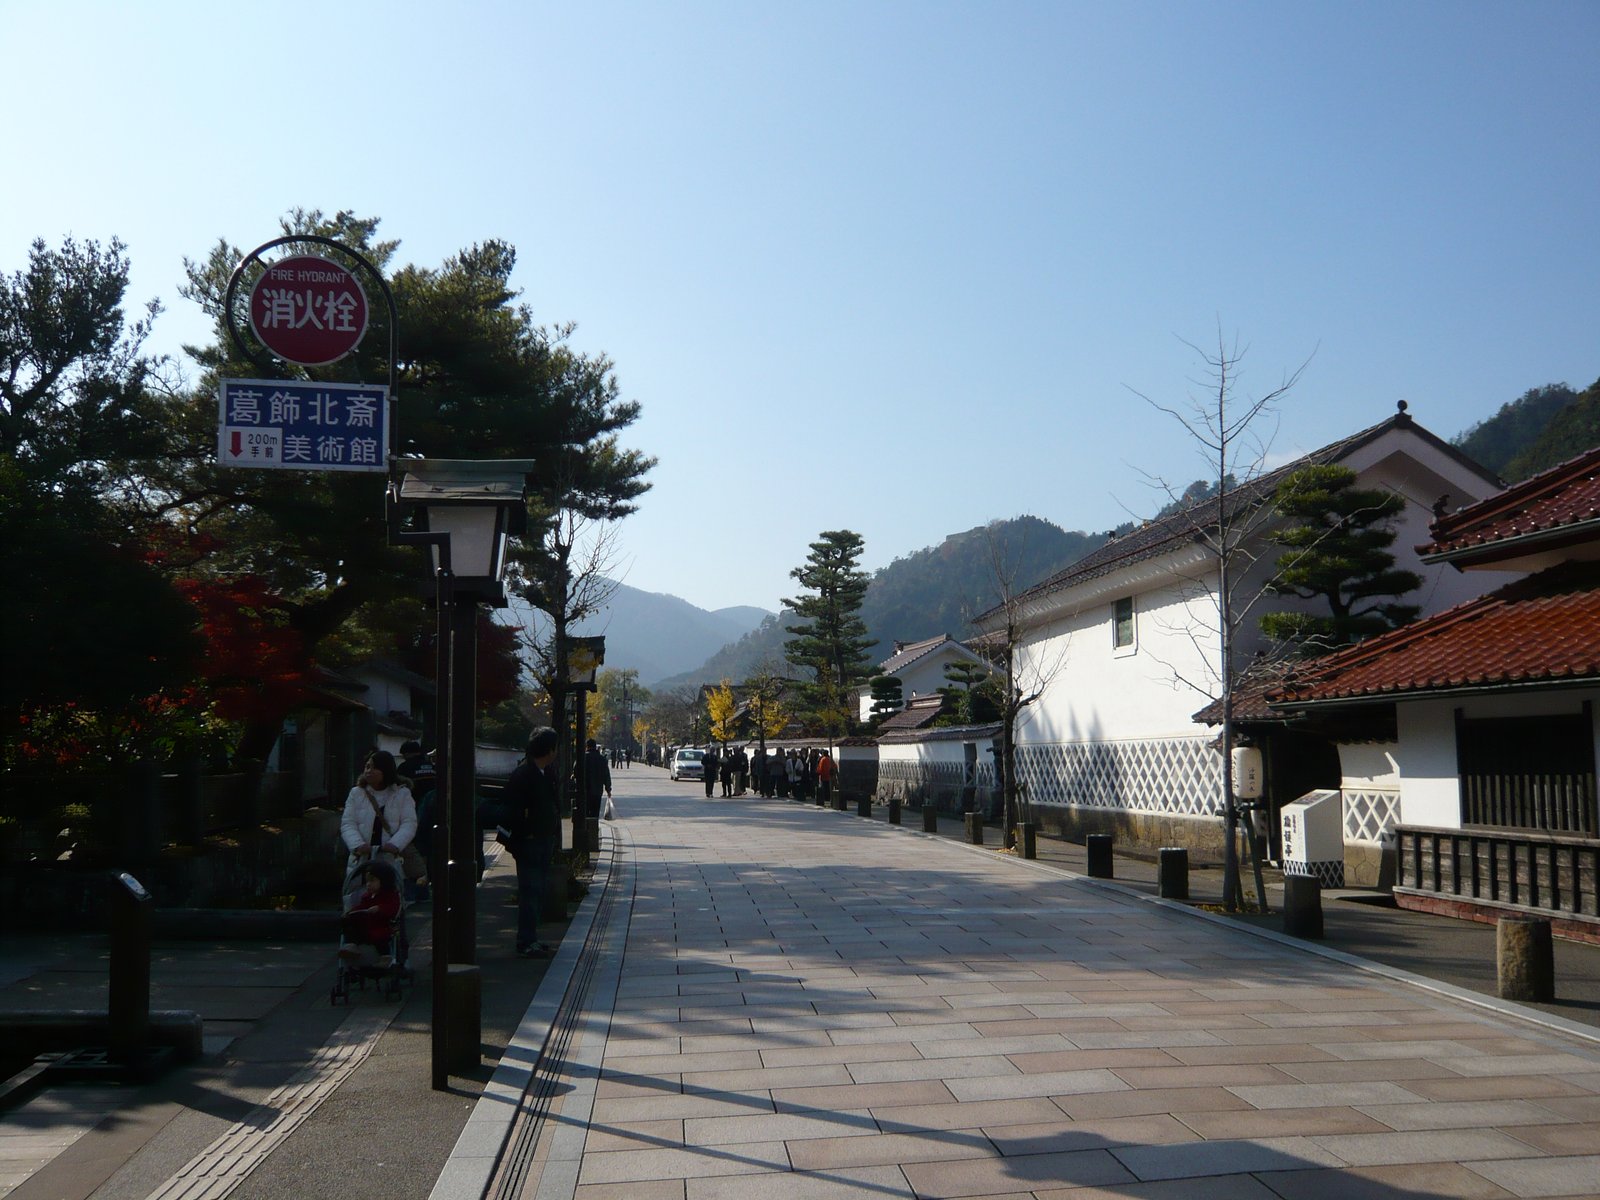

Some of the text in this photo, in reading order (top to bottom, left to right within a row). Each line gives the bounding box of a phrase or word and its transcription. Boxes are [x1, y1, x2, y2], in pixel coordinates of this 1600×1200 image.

[270, 268, 347, 284] FIRE HYDRANT
[261, 287, 358, 332] 消火栓
[227, 390, 378, 428] 葛飾北斎
[247, 433, 278, 445] 200m
[284, 434, 377, 464] 美術館
[250, 446, 274, 458] 手前
